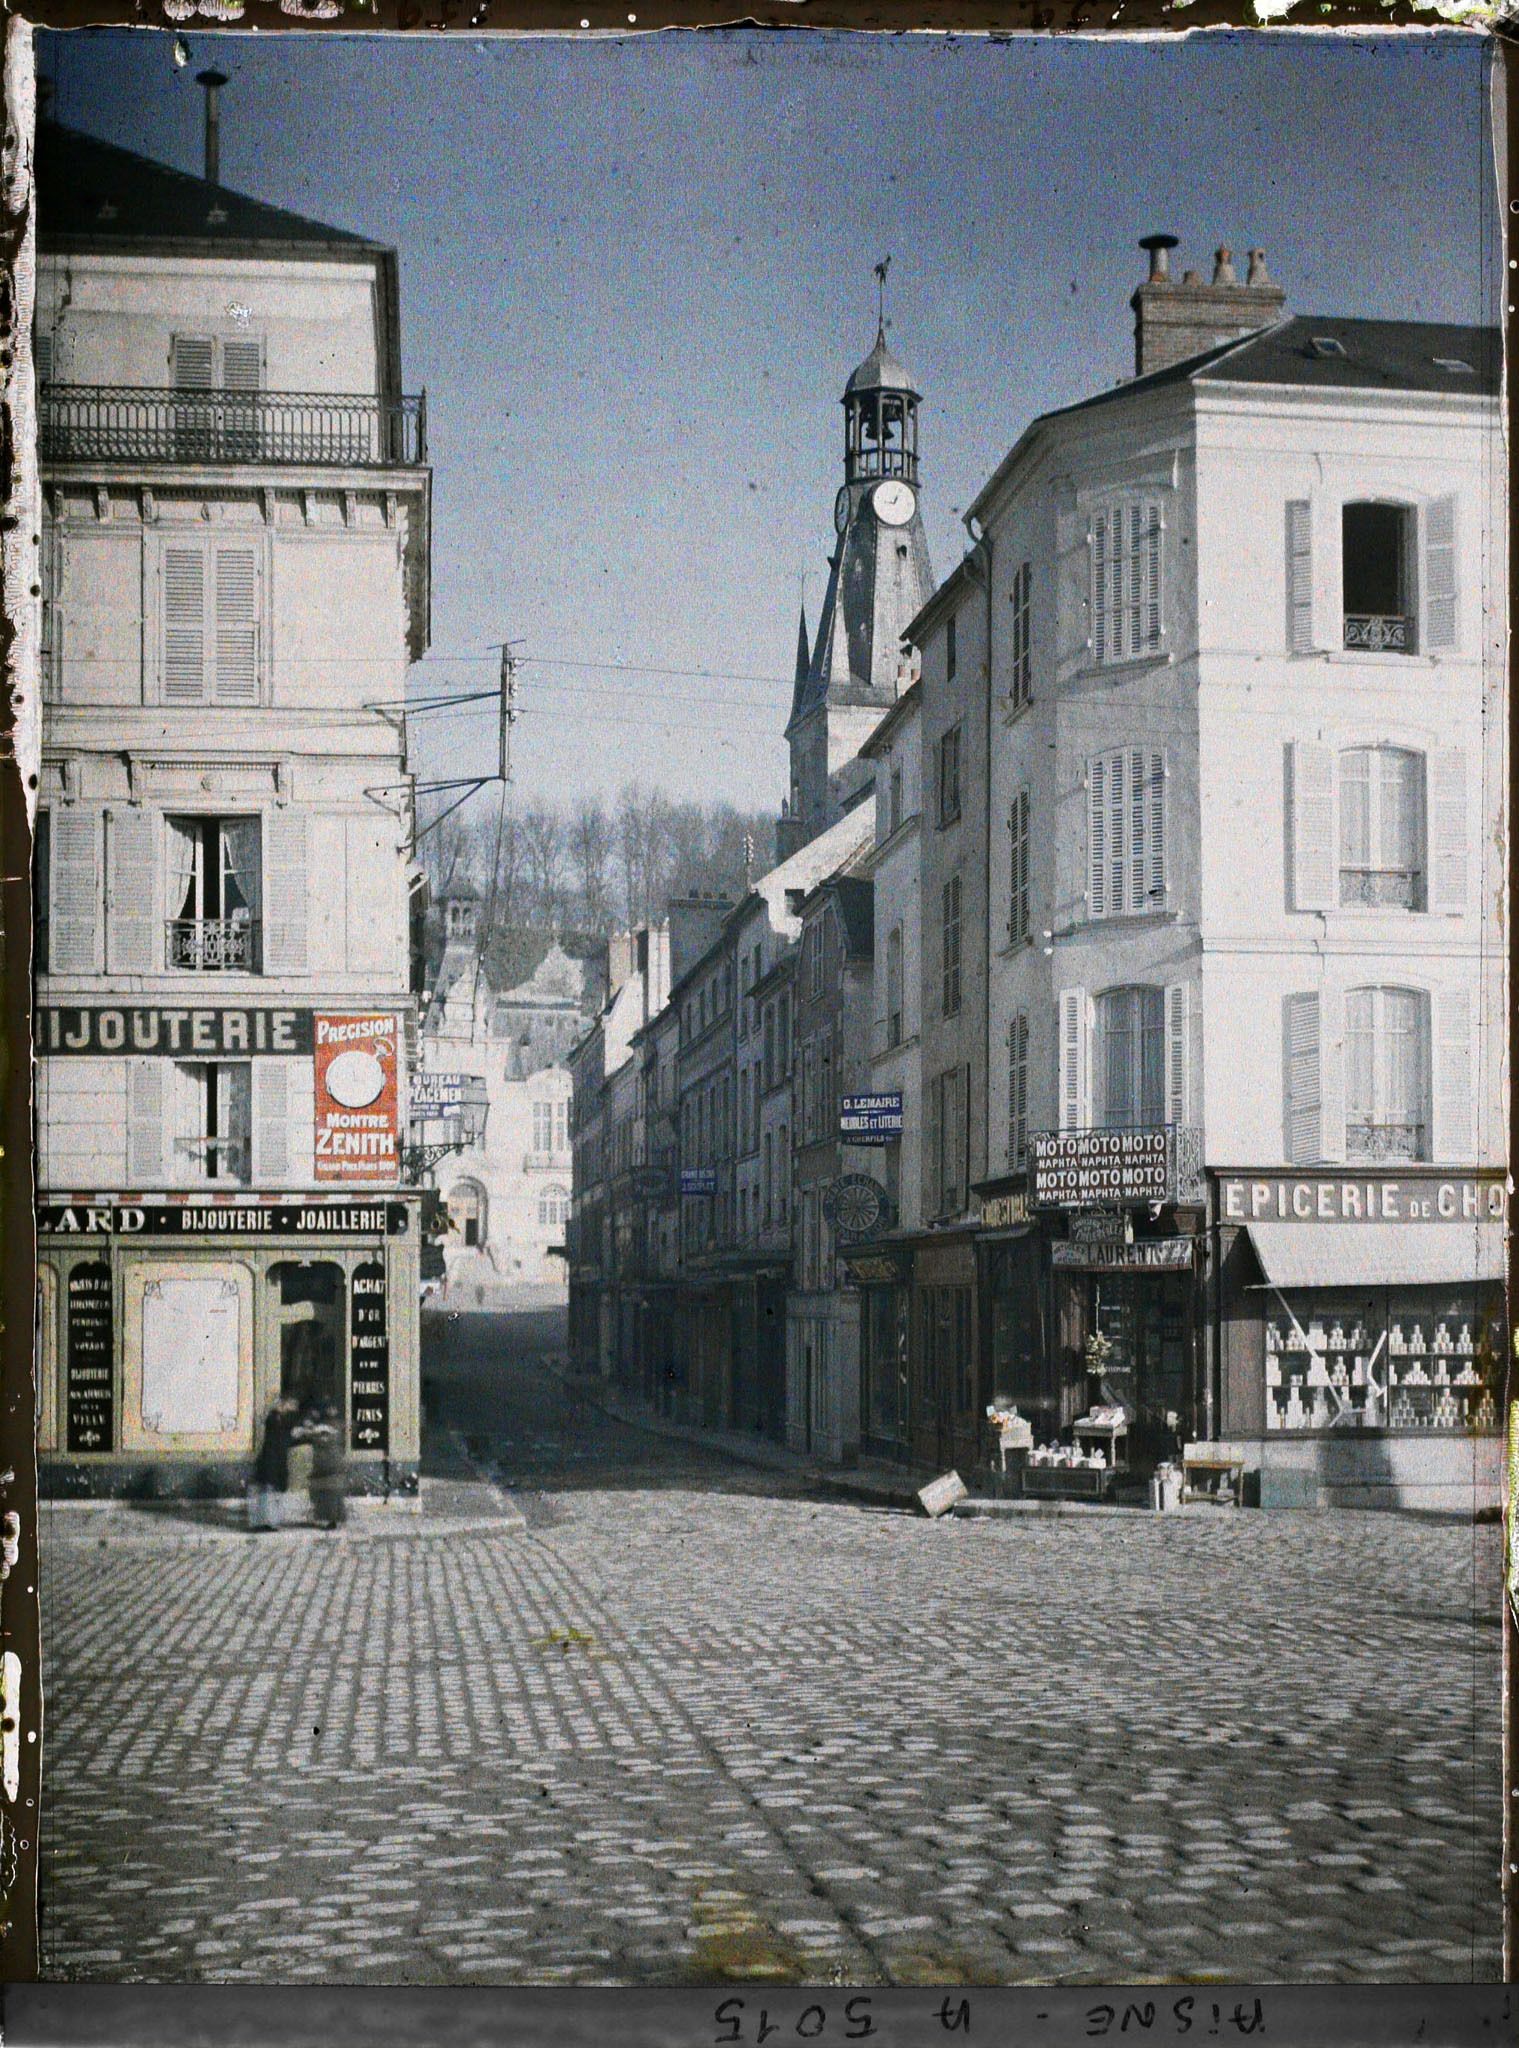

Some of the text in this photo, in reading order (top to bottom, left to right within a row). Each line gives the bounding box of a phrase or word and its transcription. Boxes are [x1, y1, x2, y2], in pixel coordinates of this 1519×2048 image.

[37, 1011, 296, 1050] IJOUTERIE
[318, 1019, 394, 1044] PRECISION
[854, 1097, 900, 1109] LEMAIRE
[327, 1113, 390, 1128] MONTRE
[316, 1129, 394, 1155] ZENITH
[1036, 1134, 1164, 1157] MOTO MOTO MOTO
[1039, 1153, 1165, 1168] NAPHTA NAPHTA NAPHTA
[1036, 1167, 1165, 1189] MOTO MOTO MOTO
[1039, 1186, 1165, 1201] NAPHTA NAPHTA NAPHTA
[1410, 1200, 1430, 1218] DE
[182, 1210, 272, 1230] BIJOUTERIE
[297, 1210, 385, 1230] JOAILLERIE
[1087, 1243, 1156, 1265] LAURENT
[353, 1279, 385, 1294] ACHAT
[358, 1309, 380, 1322] D'OR
[357, 1408, 383, 1422] FINES
